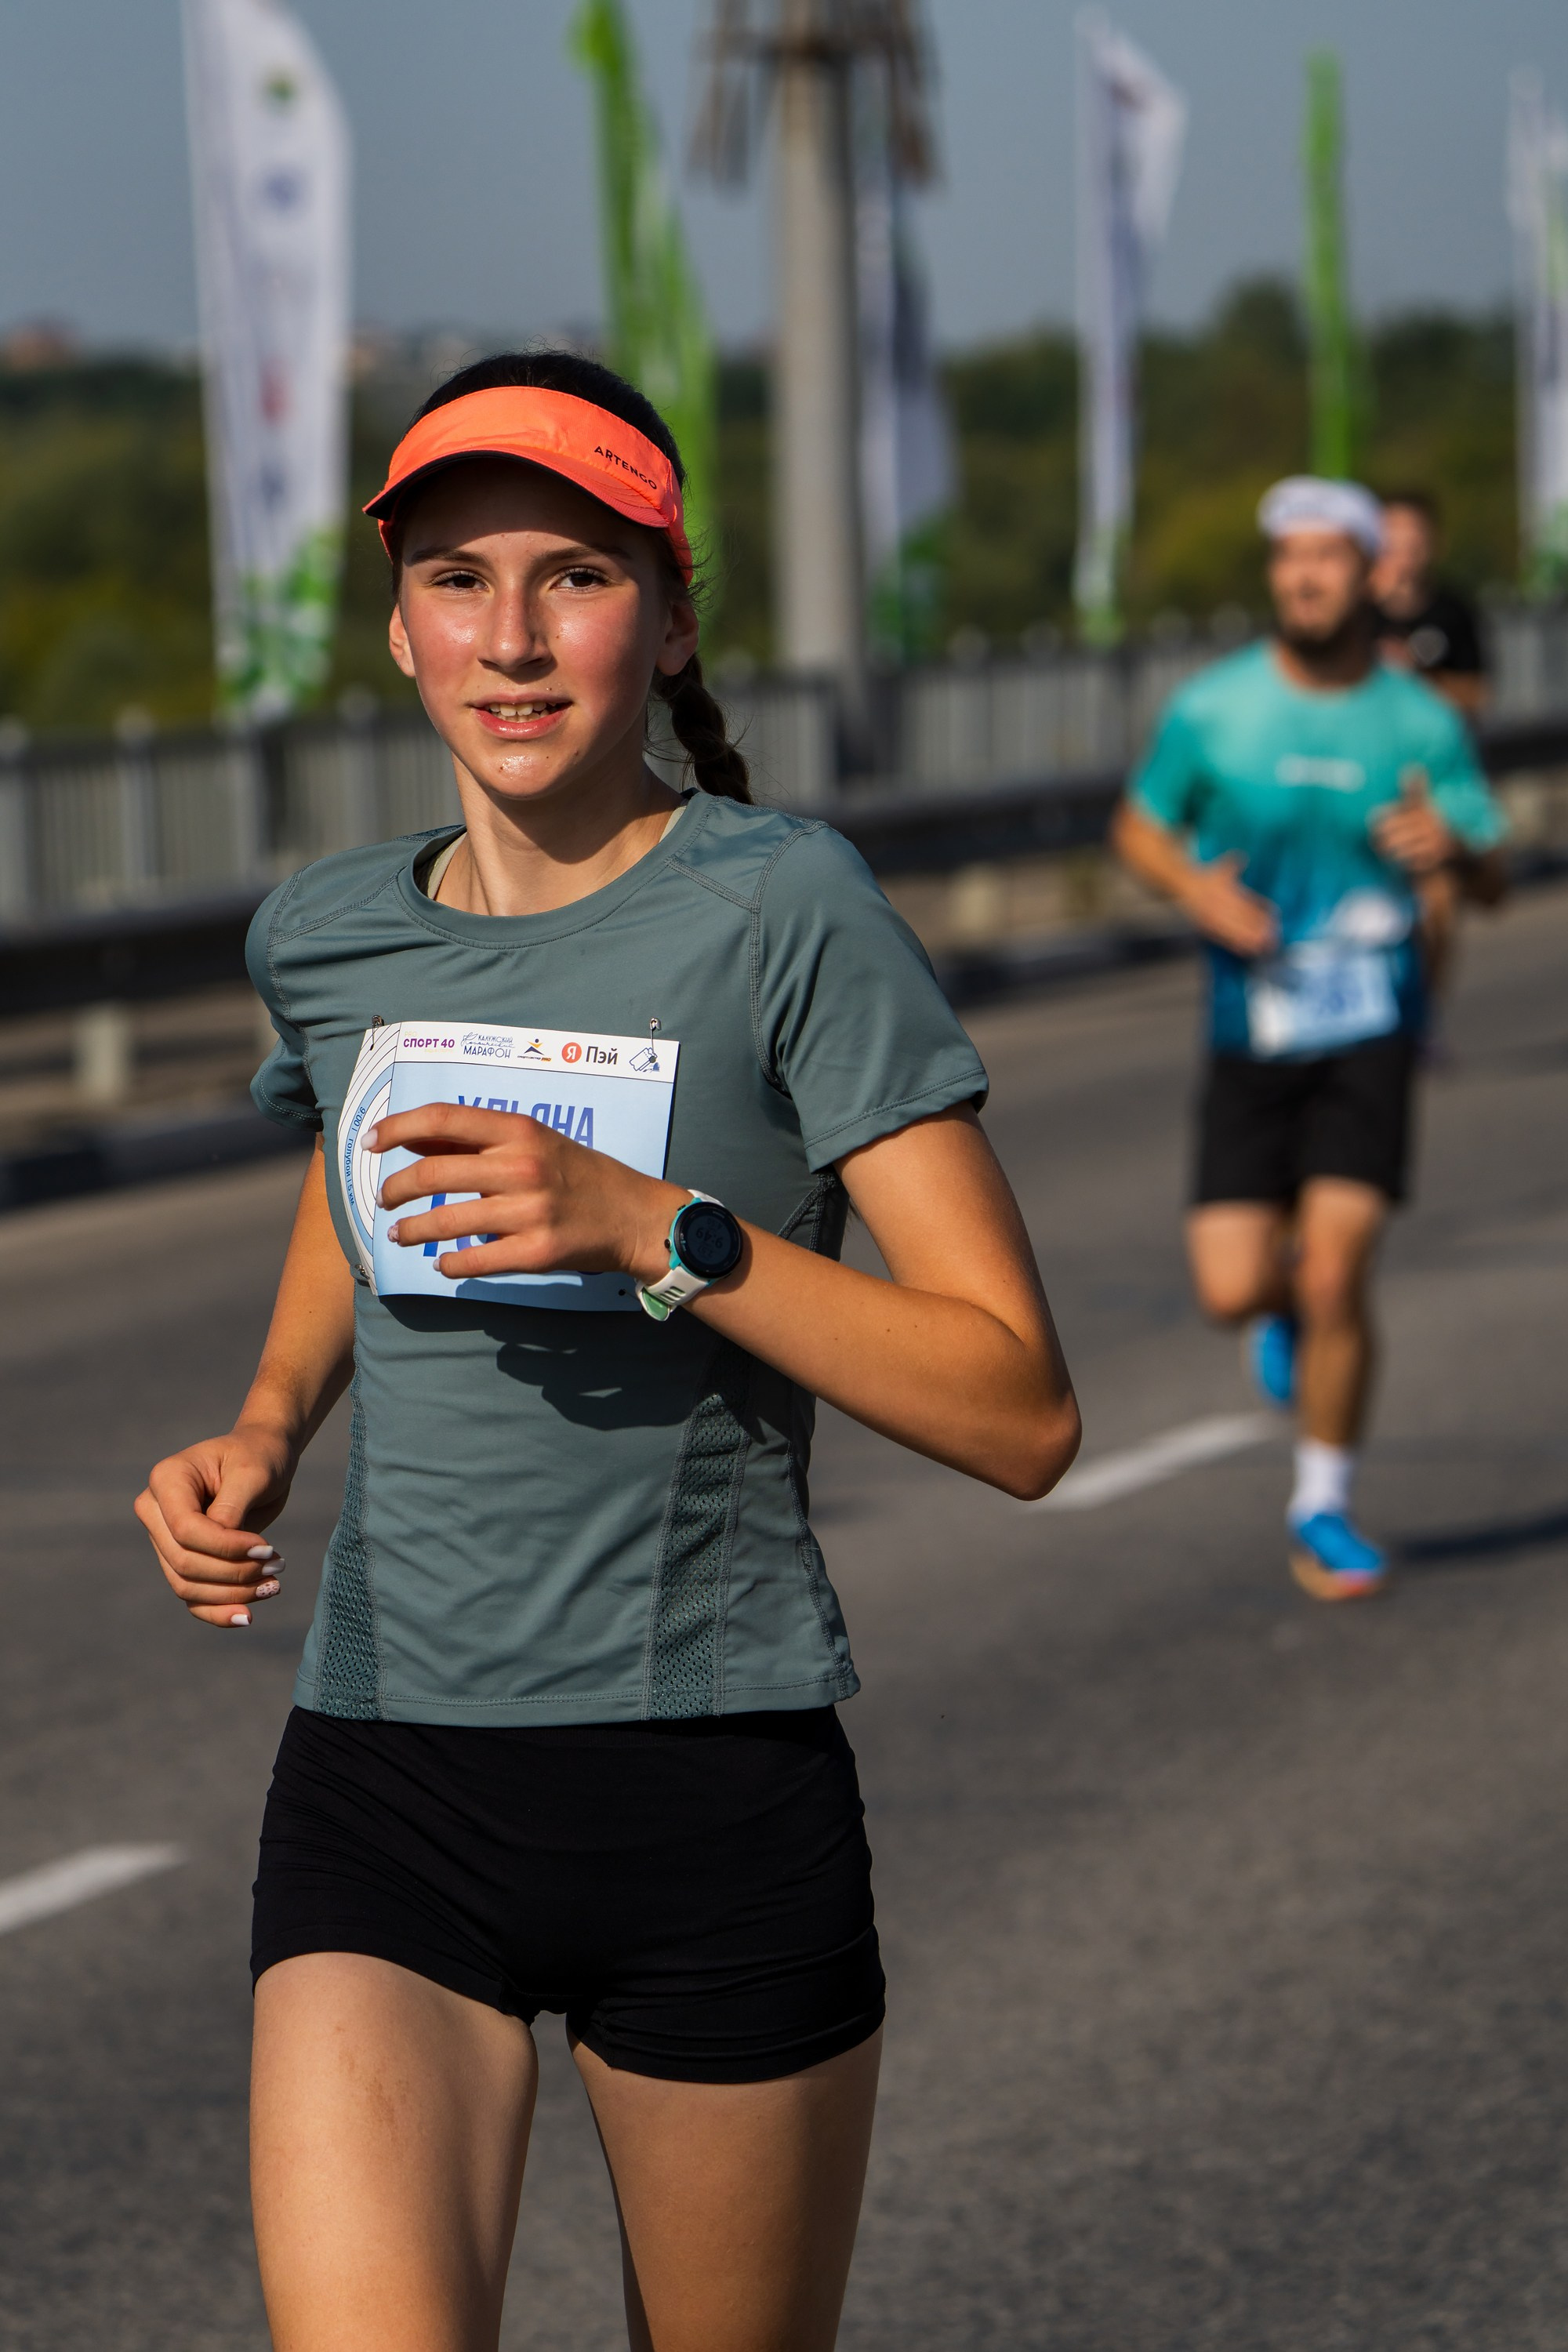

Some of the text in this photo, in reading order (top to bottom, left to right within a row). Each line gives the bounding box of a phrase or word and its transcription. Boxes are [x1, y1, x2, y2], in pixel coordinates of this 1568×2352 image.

[594, 446, 657, 489] ARTENGO
[404, 1039, 455, 1047] СПОРТ 40
[463, 1045, 511, 1058] МАРАФОН
[586, 1046, 618, 1065] Пэй
[354, 1106, 365, 1127] 9:00
